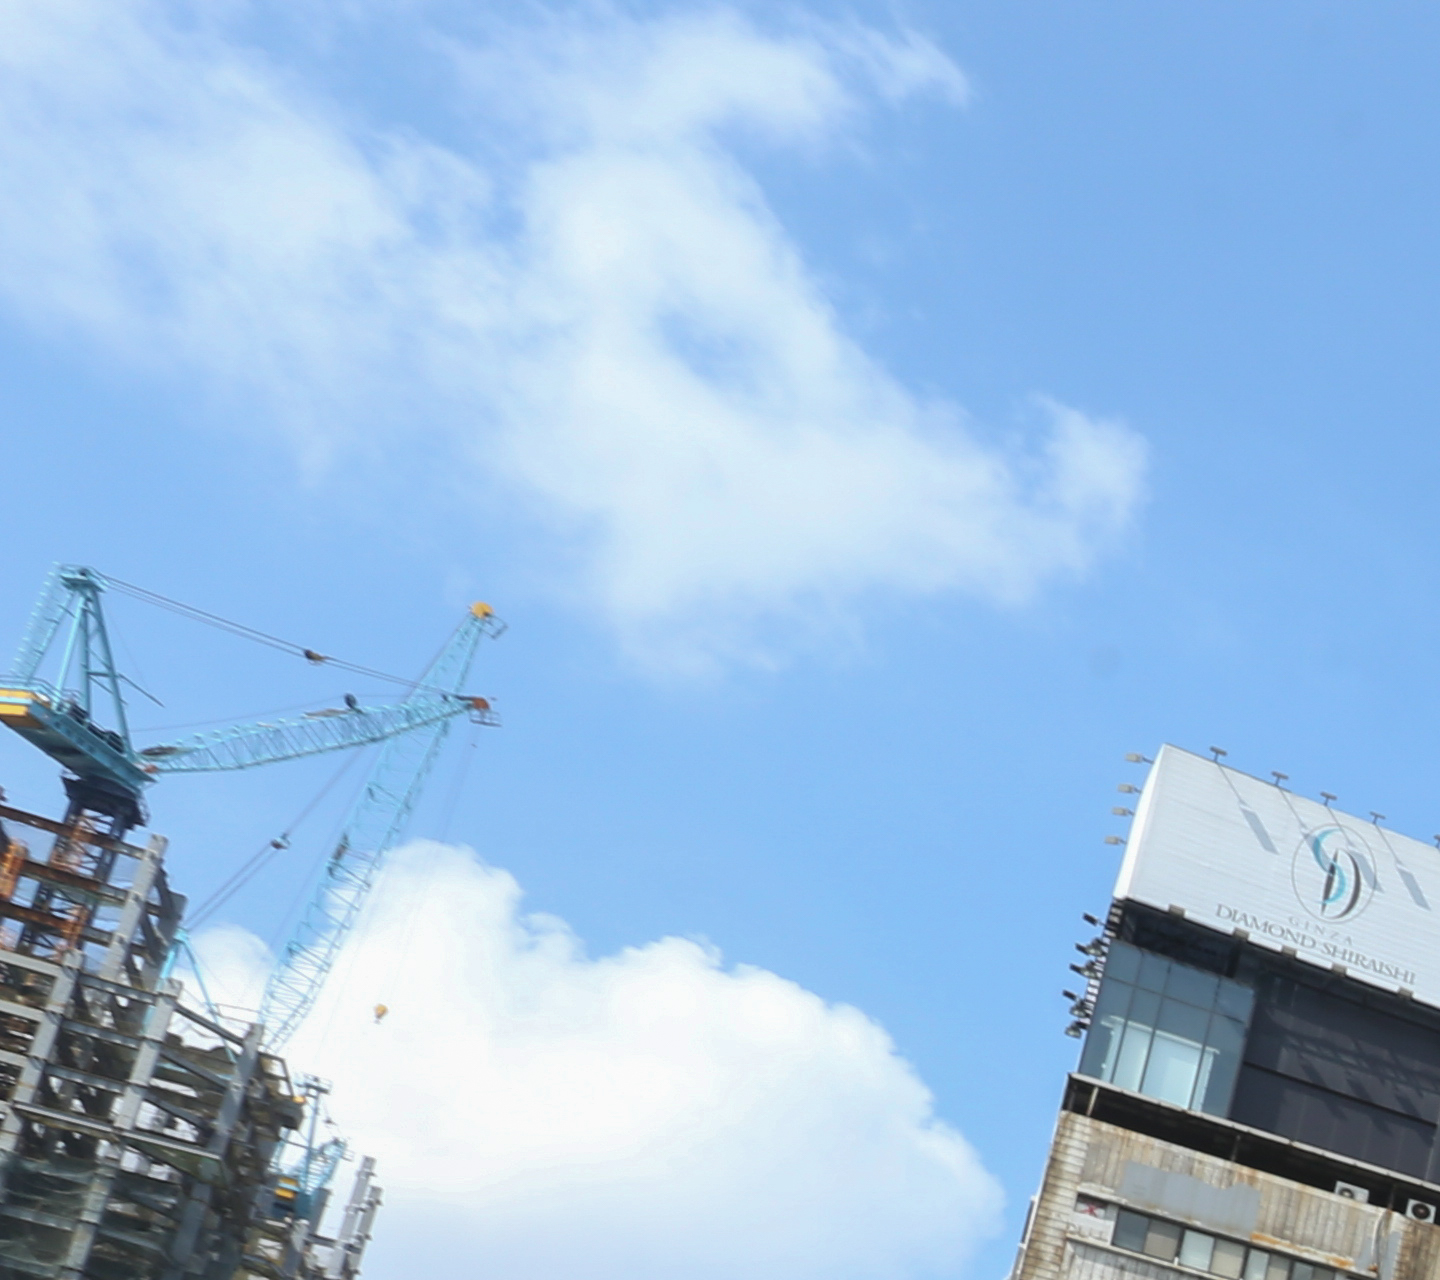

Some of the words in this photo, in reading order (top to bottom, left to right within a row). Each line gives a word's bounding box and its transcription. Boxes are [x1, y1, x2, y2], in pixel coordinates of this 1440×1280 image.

[1215, 903, 1317, 949] DIAMOND
[1322, 942, 1416, 985] SHIRAISHI
[1288, 915, 1354, 946] GINZA
